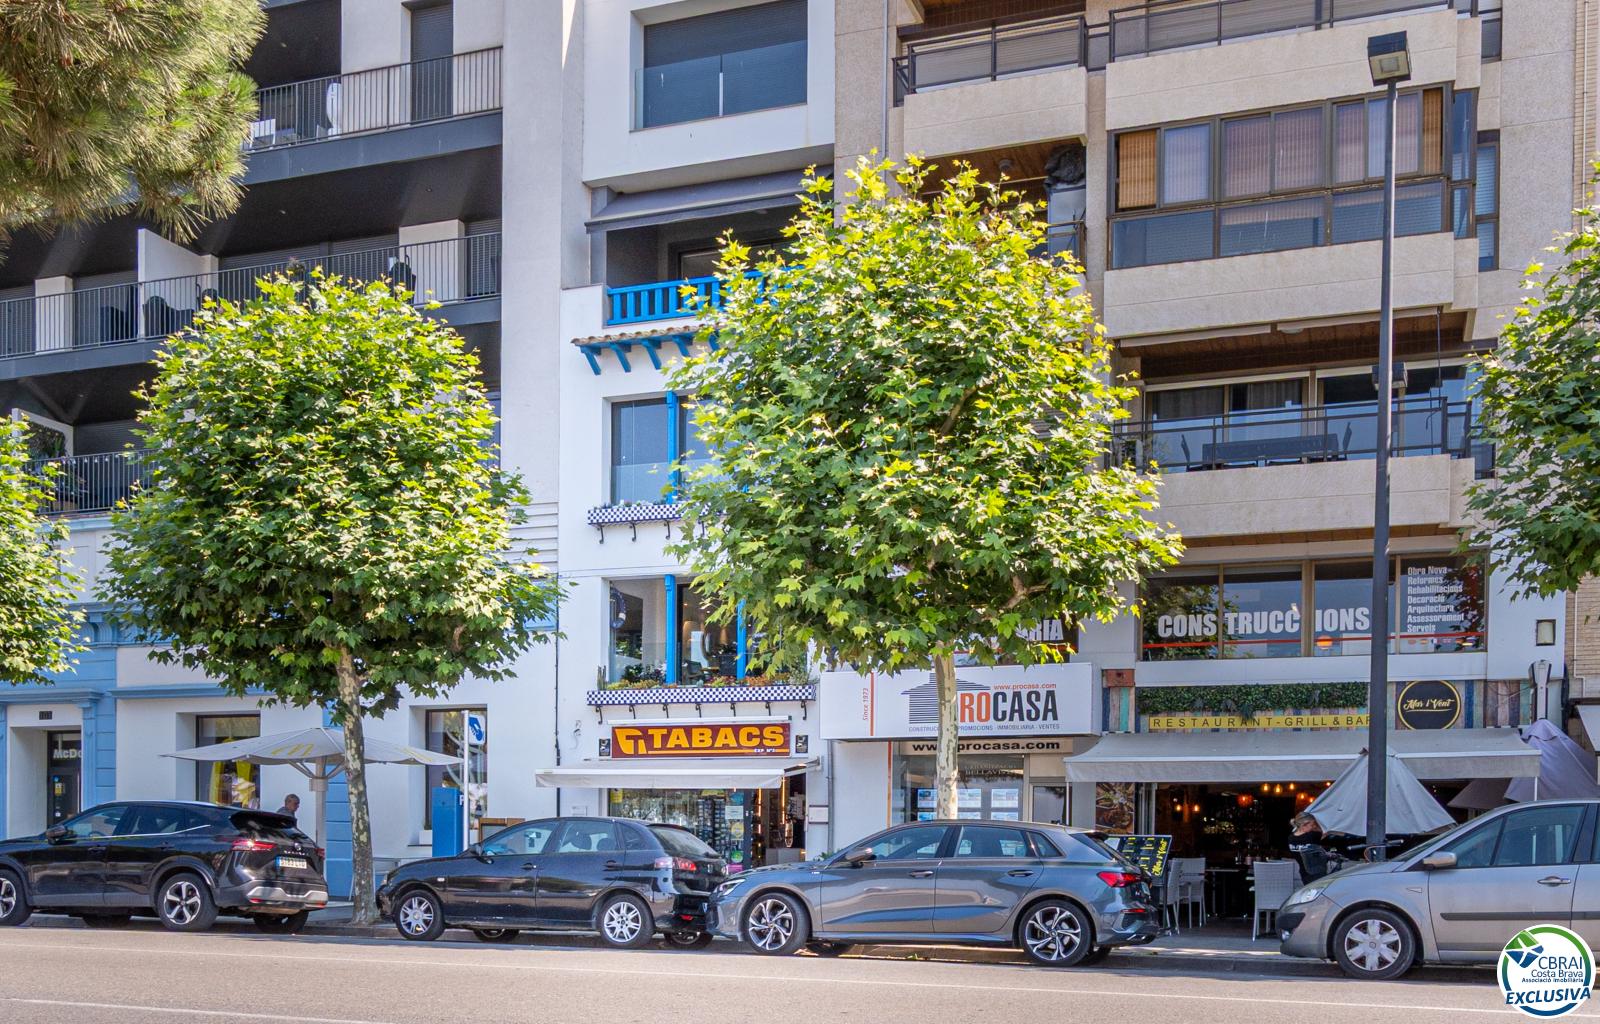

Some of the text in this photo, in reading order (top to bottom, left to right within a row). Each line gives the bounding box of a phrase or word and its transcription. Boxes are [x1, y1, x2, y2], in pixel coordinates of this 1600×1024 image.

[1407, 566, 1448, 575] Obra Nova
[1407, 576, 1444, 585] Reformes
[1407, 604, 1454, 614] Arquitectura
[959, 690, 1059, 723] ROCASA
[648, 726, 785, 749] TABACS
[912, 742, 1060, 753] wwprocasa.com
